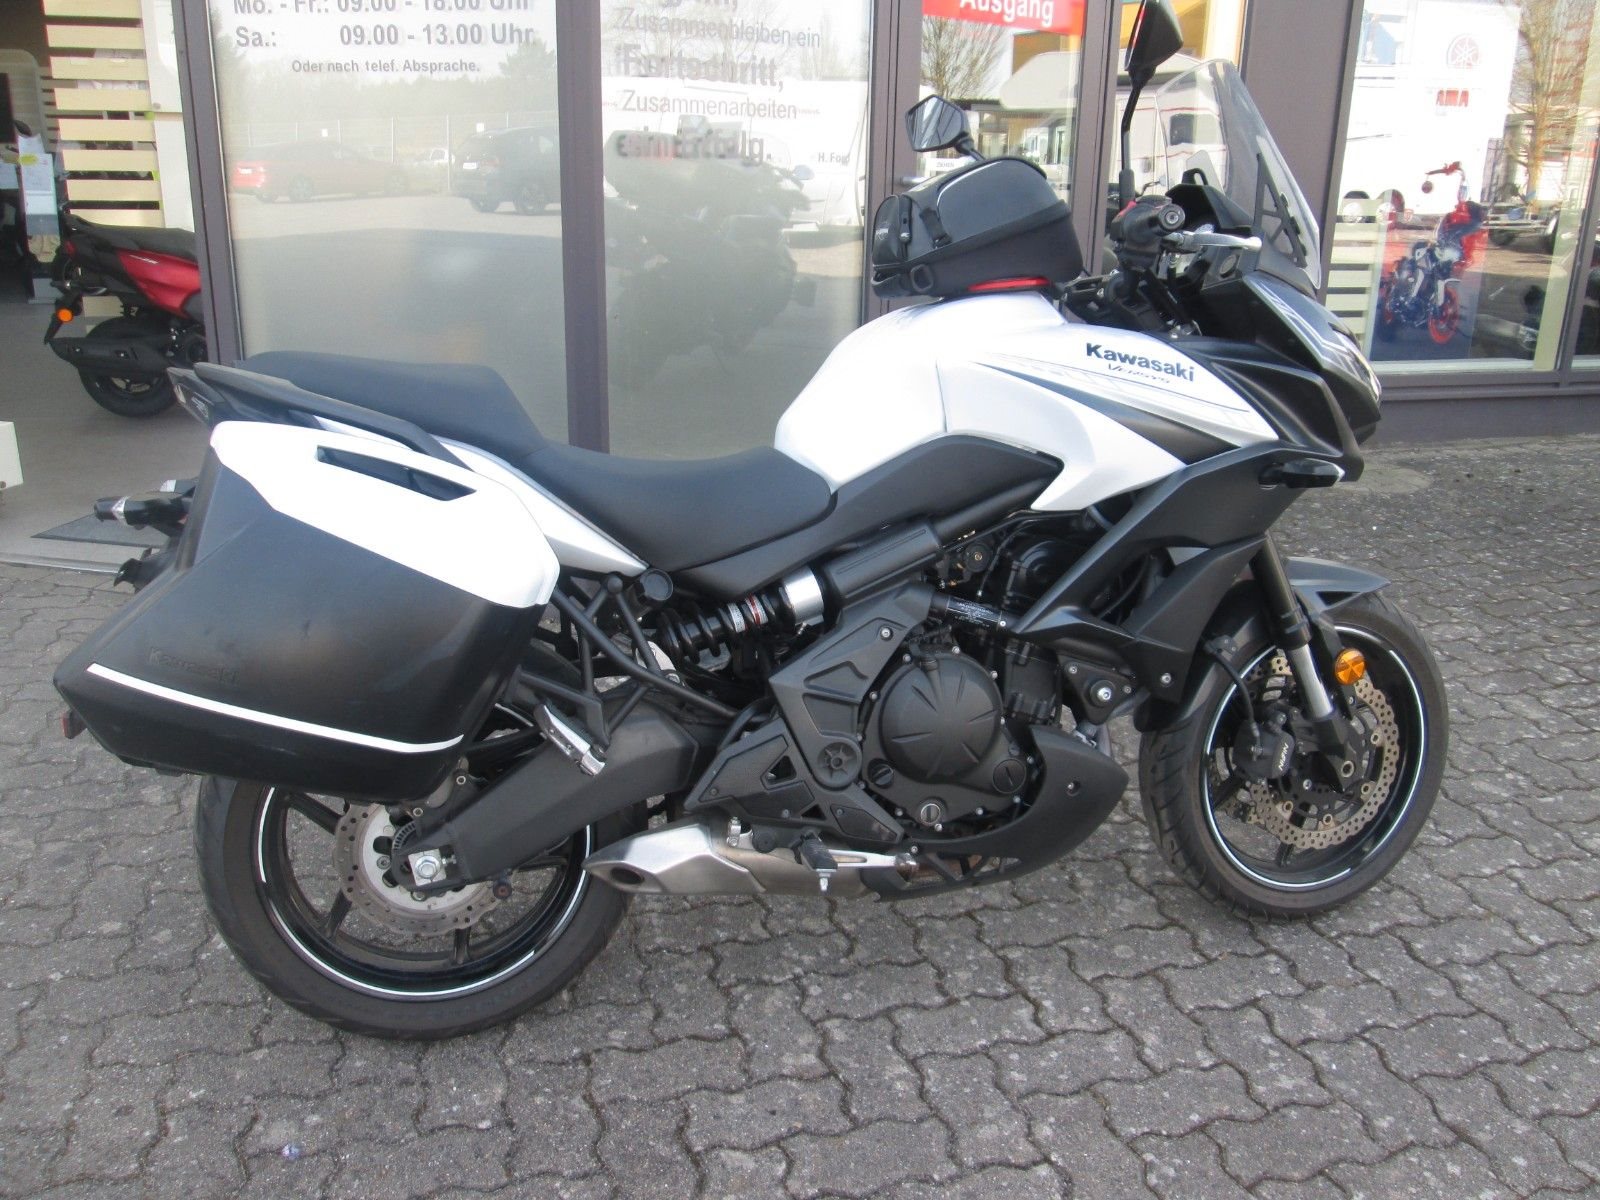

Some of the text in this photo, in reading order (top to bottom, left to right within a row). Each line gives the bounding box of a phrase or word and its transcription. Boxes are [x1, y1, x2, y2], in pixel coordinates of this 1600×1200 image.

[233, 0, 272, 14] Mo.
[235, 26, 277, 47] Sa.:
[340, 24, 399, 45] 09.00
[423, 23, 483, 45] 13.00
[491, 23, 534, 45] Uhr
[796, 27, 820, 48] ein
[291, 59, 481, 74] Oder nach telef. Absprache.
[622, 89, 797, 119] Zusammenarbeiten
[1086, 342, 1195, 382] Kawasaki
